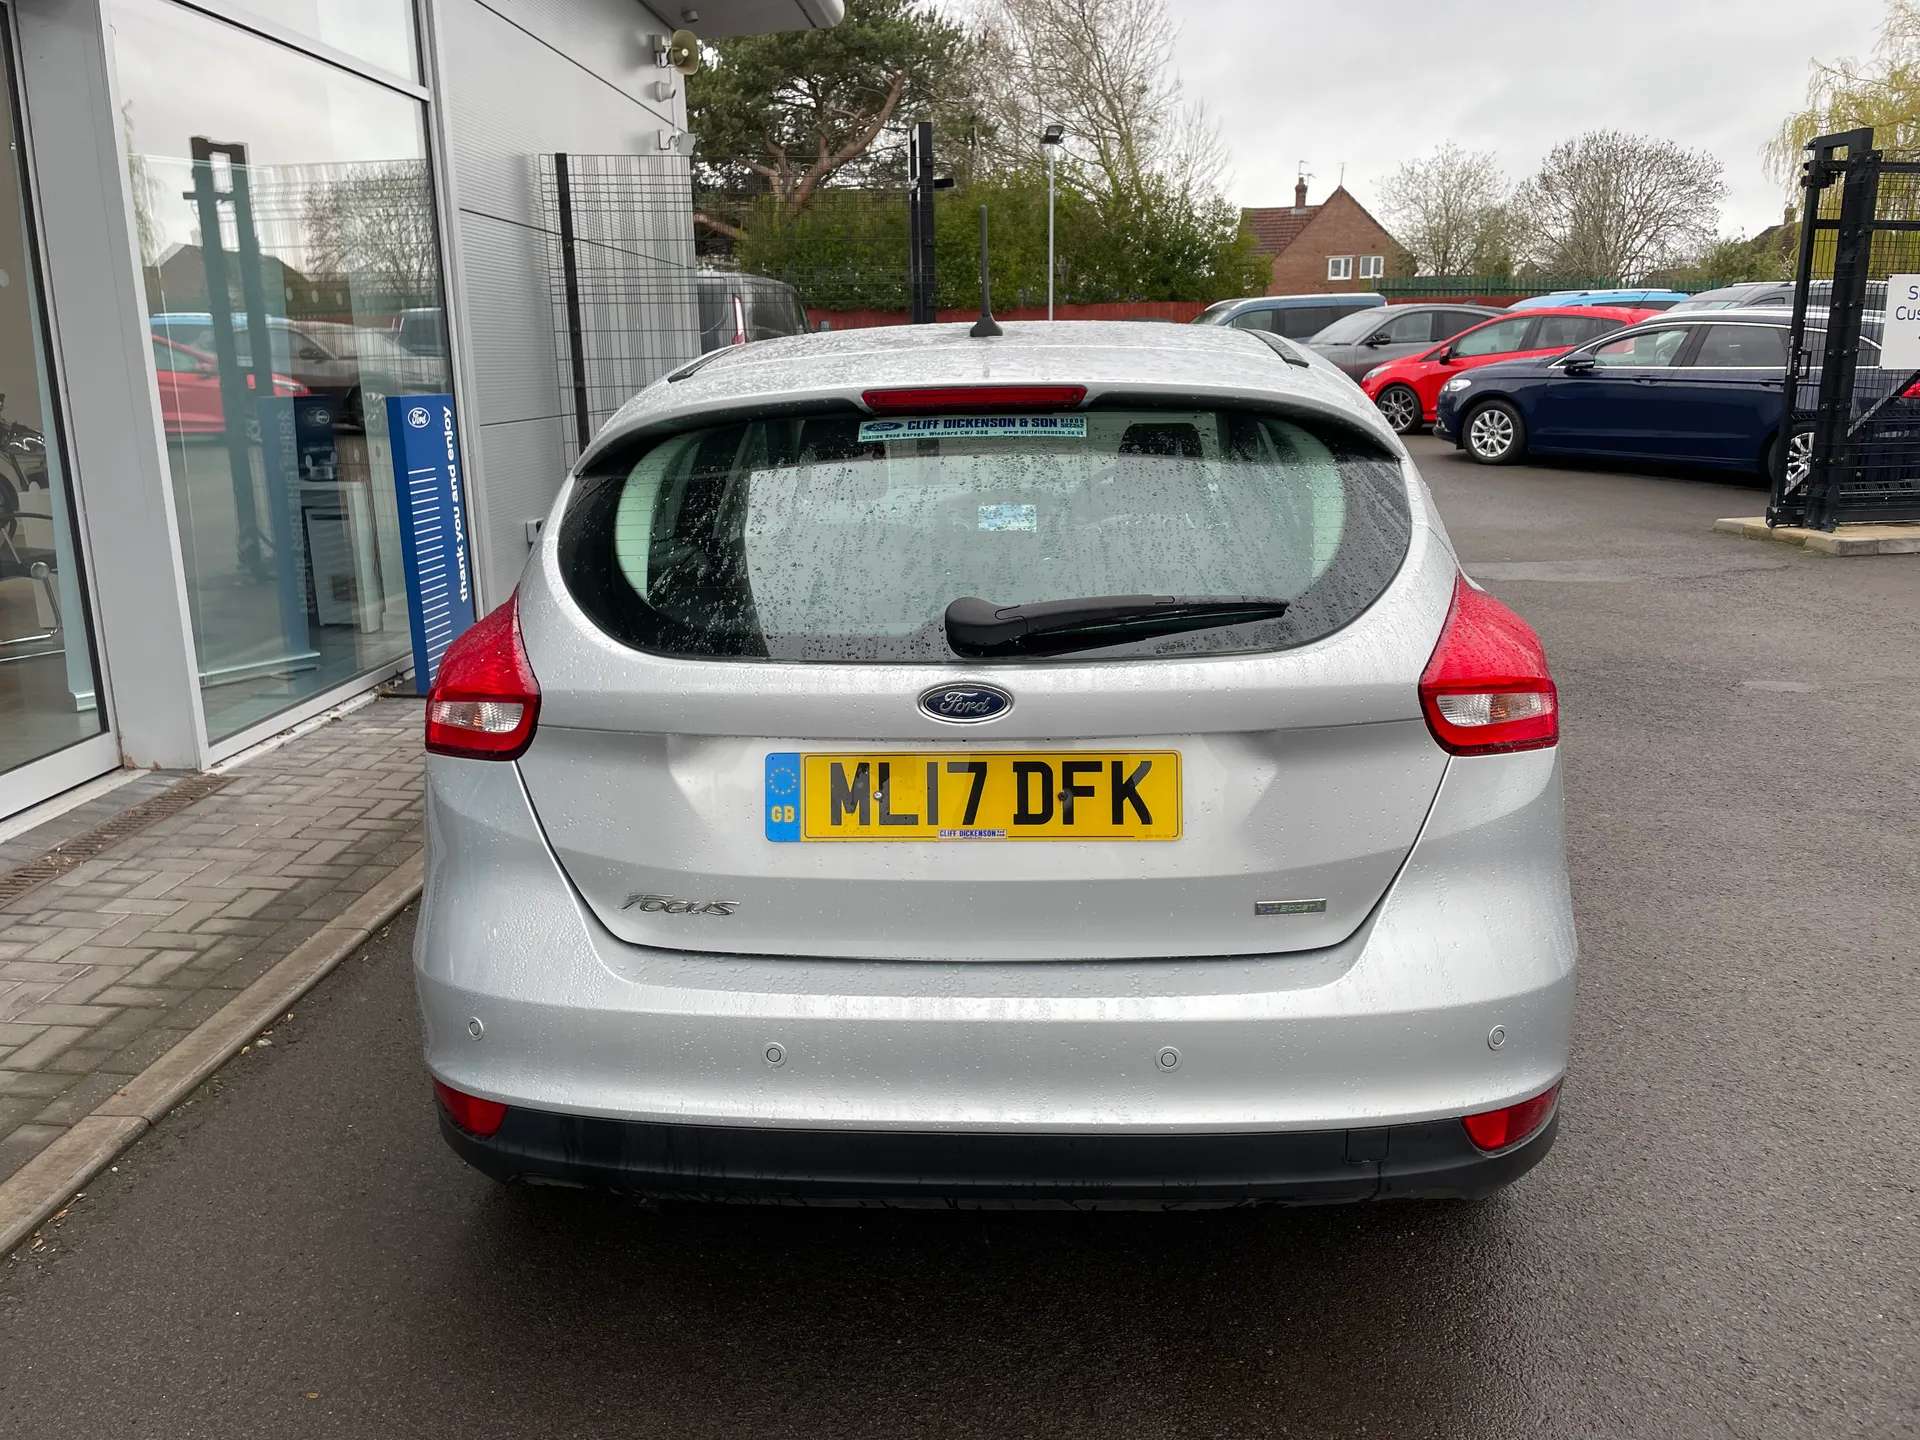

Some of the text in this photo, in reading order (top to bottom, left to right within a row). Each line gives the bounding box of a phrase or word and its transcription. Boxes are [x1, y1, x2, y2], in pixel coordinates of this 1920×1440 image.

[1907, 285, 1920, 300] S
[907, 419, 940, 430] CLIFF
[943, 418, 1016, 429] DICKENSON
[1019, 418, 1028, 428] &
[1031, 418, 1058, 428] SON
[443, 406, 468, 603] thank you and enjoy
[939, 691, 991, 714] Ford
[830, 760, 1153, 826] ML17 DFK
[771, 805, 796, 823] GB
[939, 829, 958, 837] CLIFF
[959, 829, 997, 837] DICKENSON
